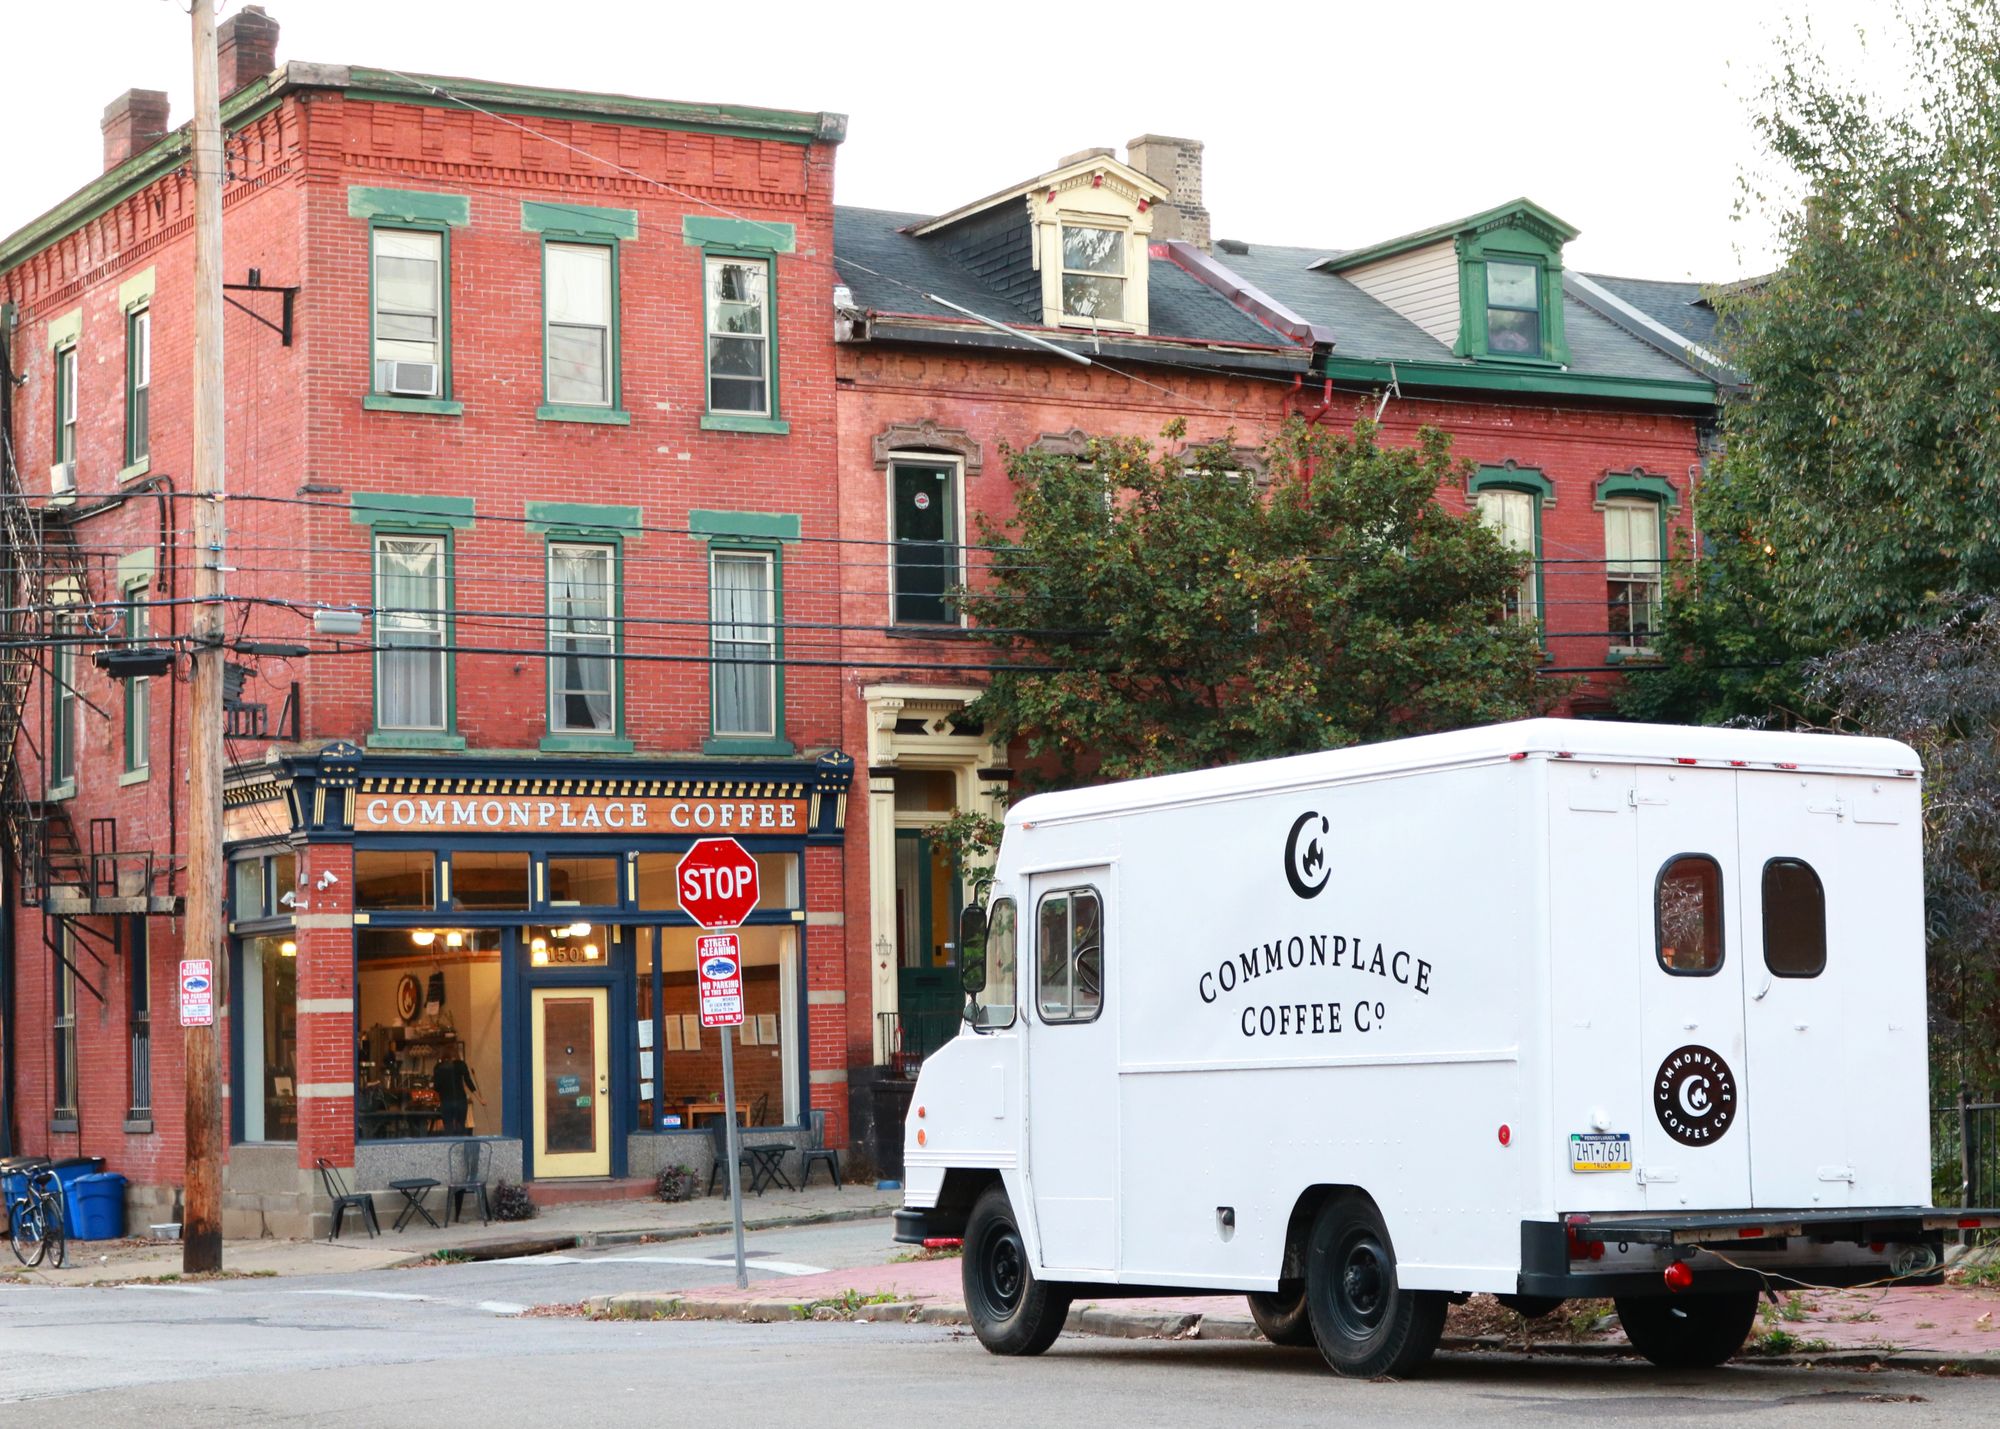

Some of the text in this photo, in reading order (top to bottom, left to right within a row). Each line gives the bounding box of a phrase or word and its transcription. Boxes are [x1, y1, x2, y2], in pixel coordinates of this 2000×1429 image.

[366, 800, 796, 828] COMMONPLACE COFFEE
[683, 866, 752, 900] STOP
[701, 946, 736, 957] CLEANING
[704, 937, 730, 948] STREET
[1200, 935, 1432, 1003] COMMONPLACE
[702, 980, 739, 990] NO PARKING
[1241, 1002, 1342, 1036] COFFEE
[1660, 1053, 1730, 1101] COMMONPLACE
[1665, 1110, 1709, 1138] COFFEE
